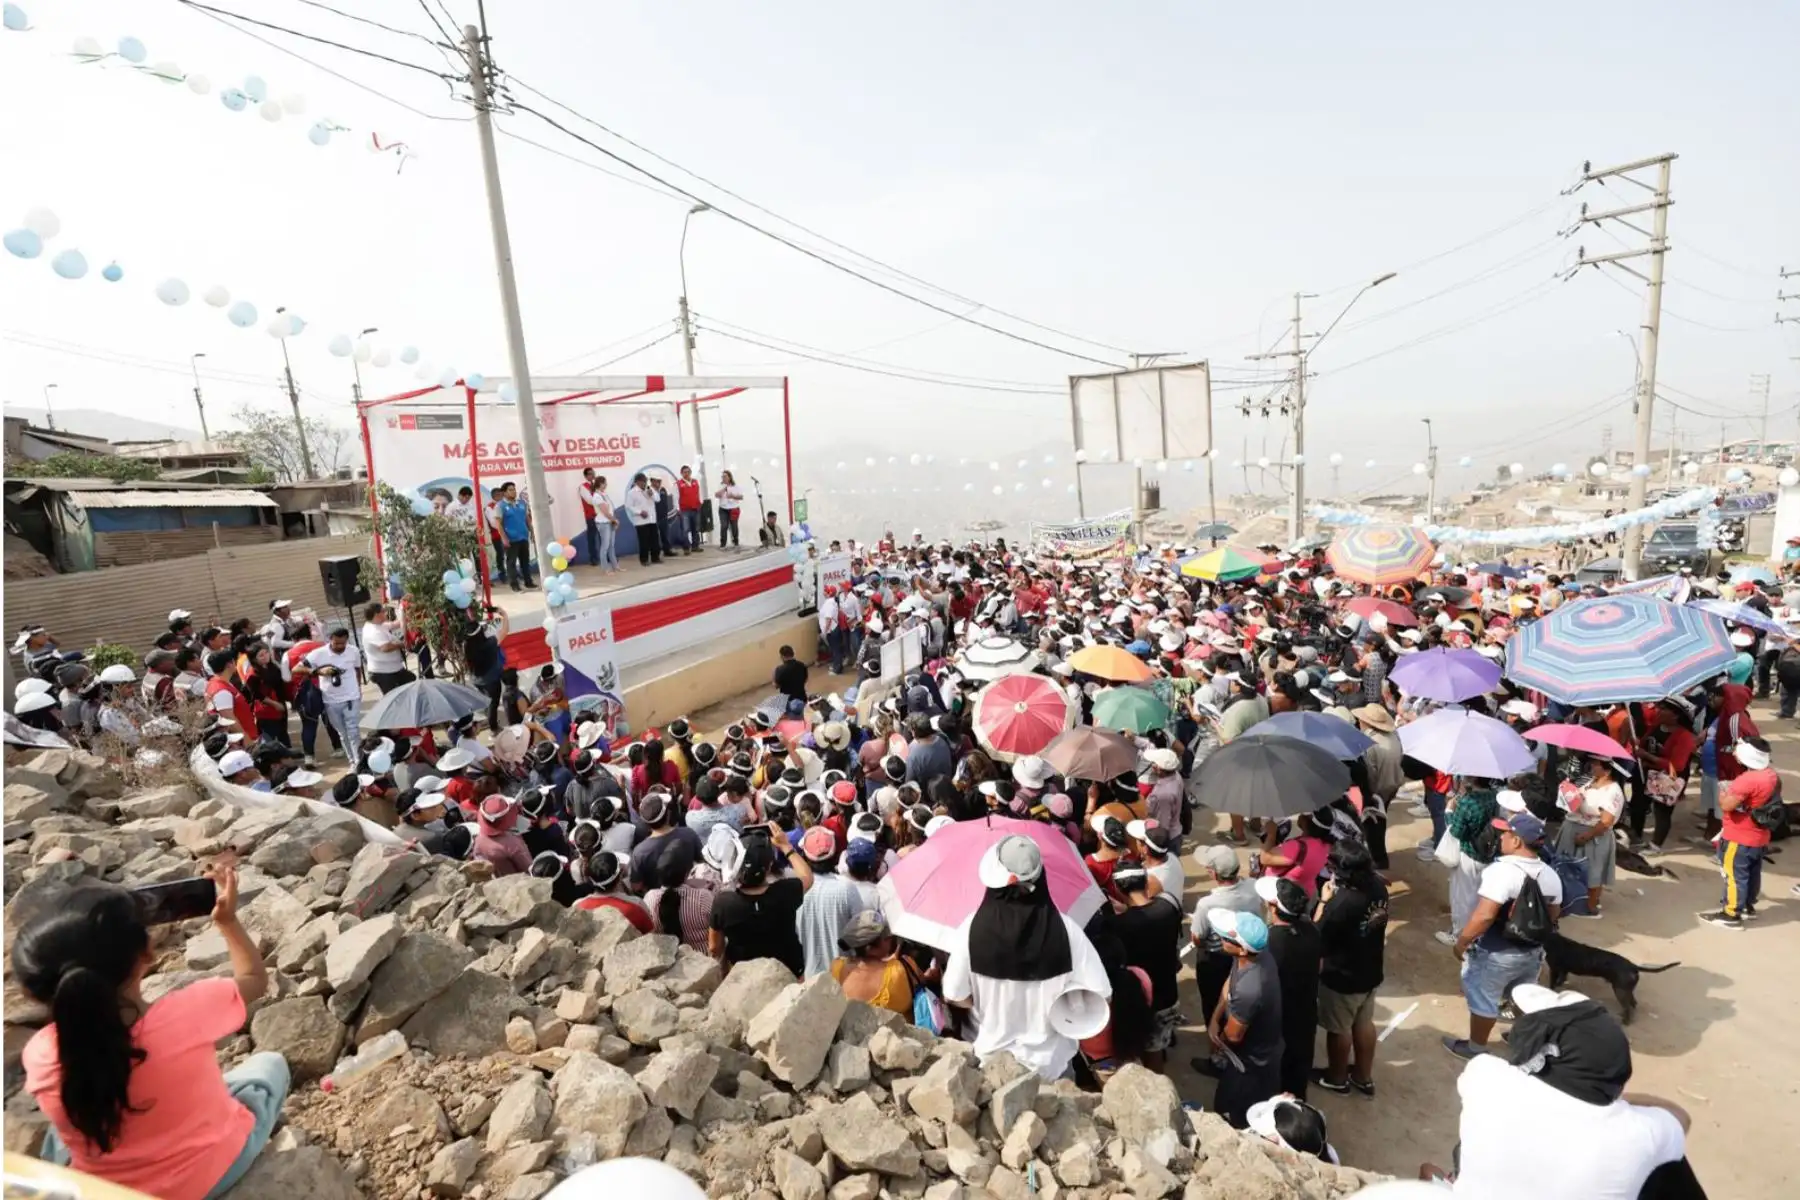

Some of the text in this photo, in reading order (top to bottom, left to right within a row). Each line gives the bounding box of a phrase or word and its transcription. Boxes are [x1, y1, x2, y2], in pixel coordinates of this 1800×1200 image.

[548, 439, 560, 453] Y
[565, 433, 640, 452] DESAGÜE
[565, 457, 583, 467] DEL
[584, 455, 621, 465] TRIUNFO
[568, 627, 607, 651] PASLC
